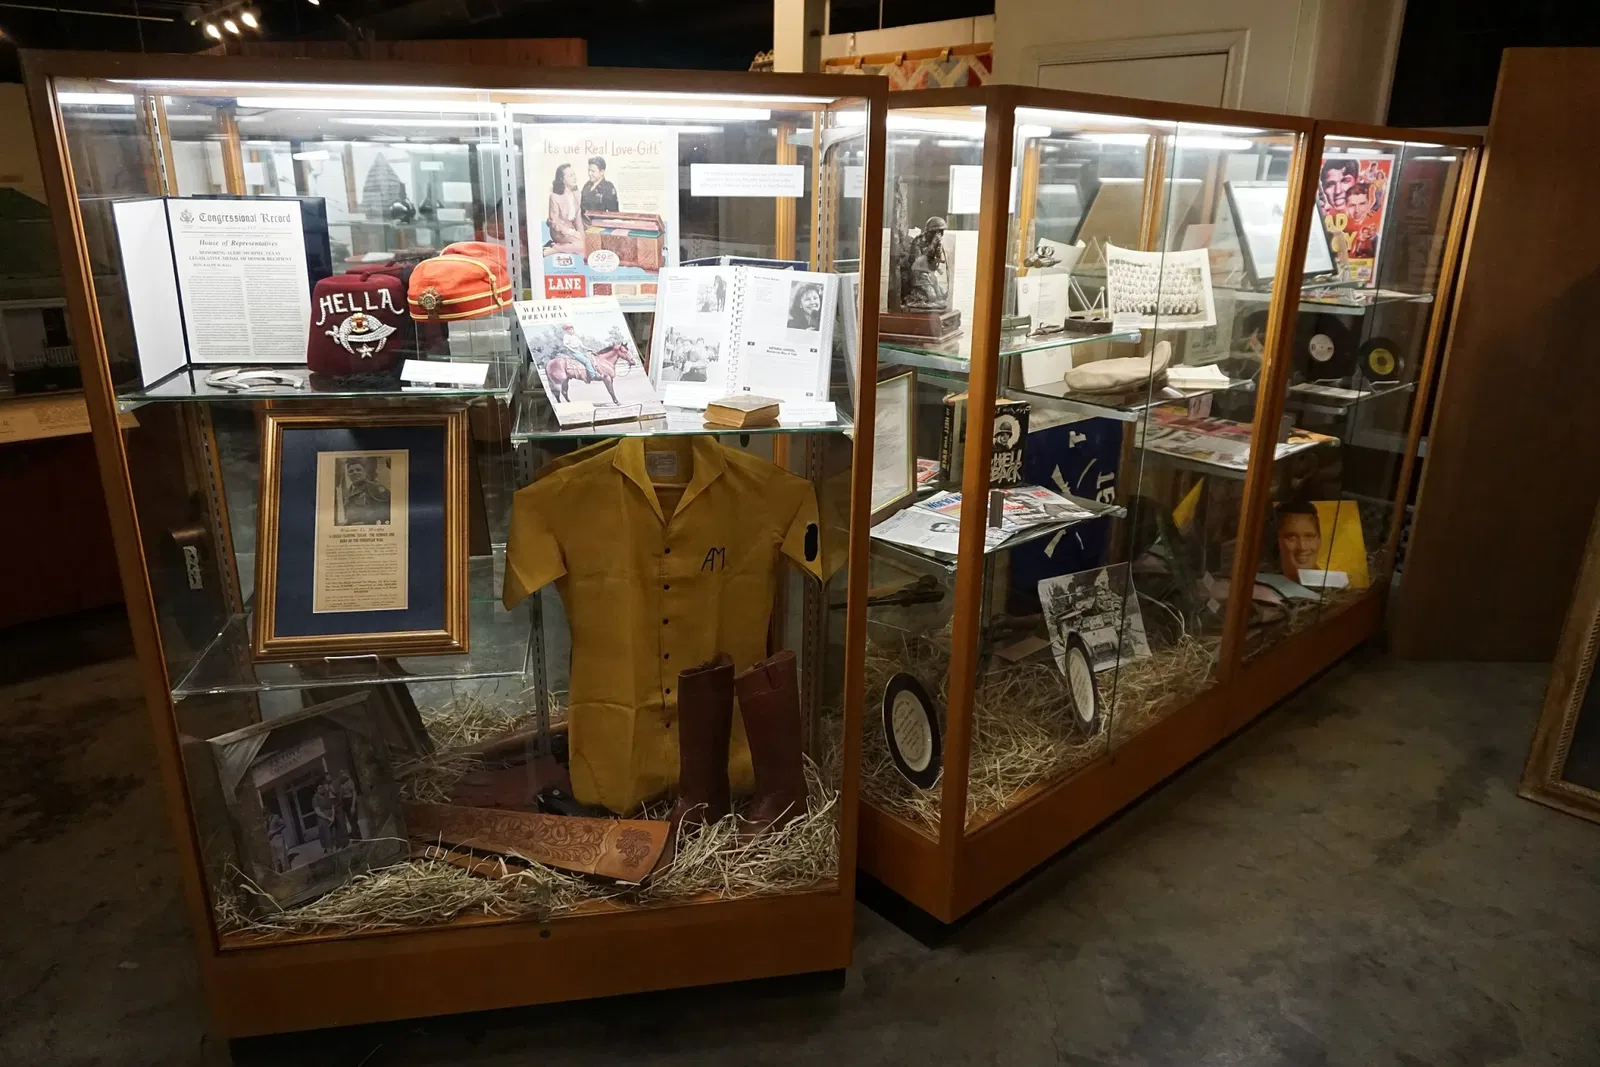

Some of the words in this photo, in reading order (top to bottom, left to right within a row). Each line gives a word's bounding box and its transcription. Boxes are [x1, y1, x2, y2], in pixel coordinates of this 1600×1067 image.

[584, 139, 608, 155] Real
[198, 212, 257, 224] Congressional
[260, 213, 292, 223] Record
[1325, 212, 1348, 233] AD
[199, 239, 219, 247] House
[221, 239, 229, 247] of
[231, 239, 278, 248] Representatives
[1331, 231, 1358, 252] OY
[548, 277, 582, 291] LANE
[316, 288, 404, 326] HELLA
[990, 462, 1022, 483] BACK
[701, 547, 726, 572] AM
